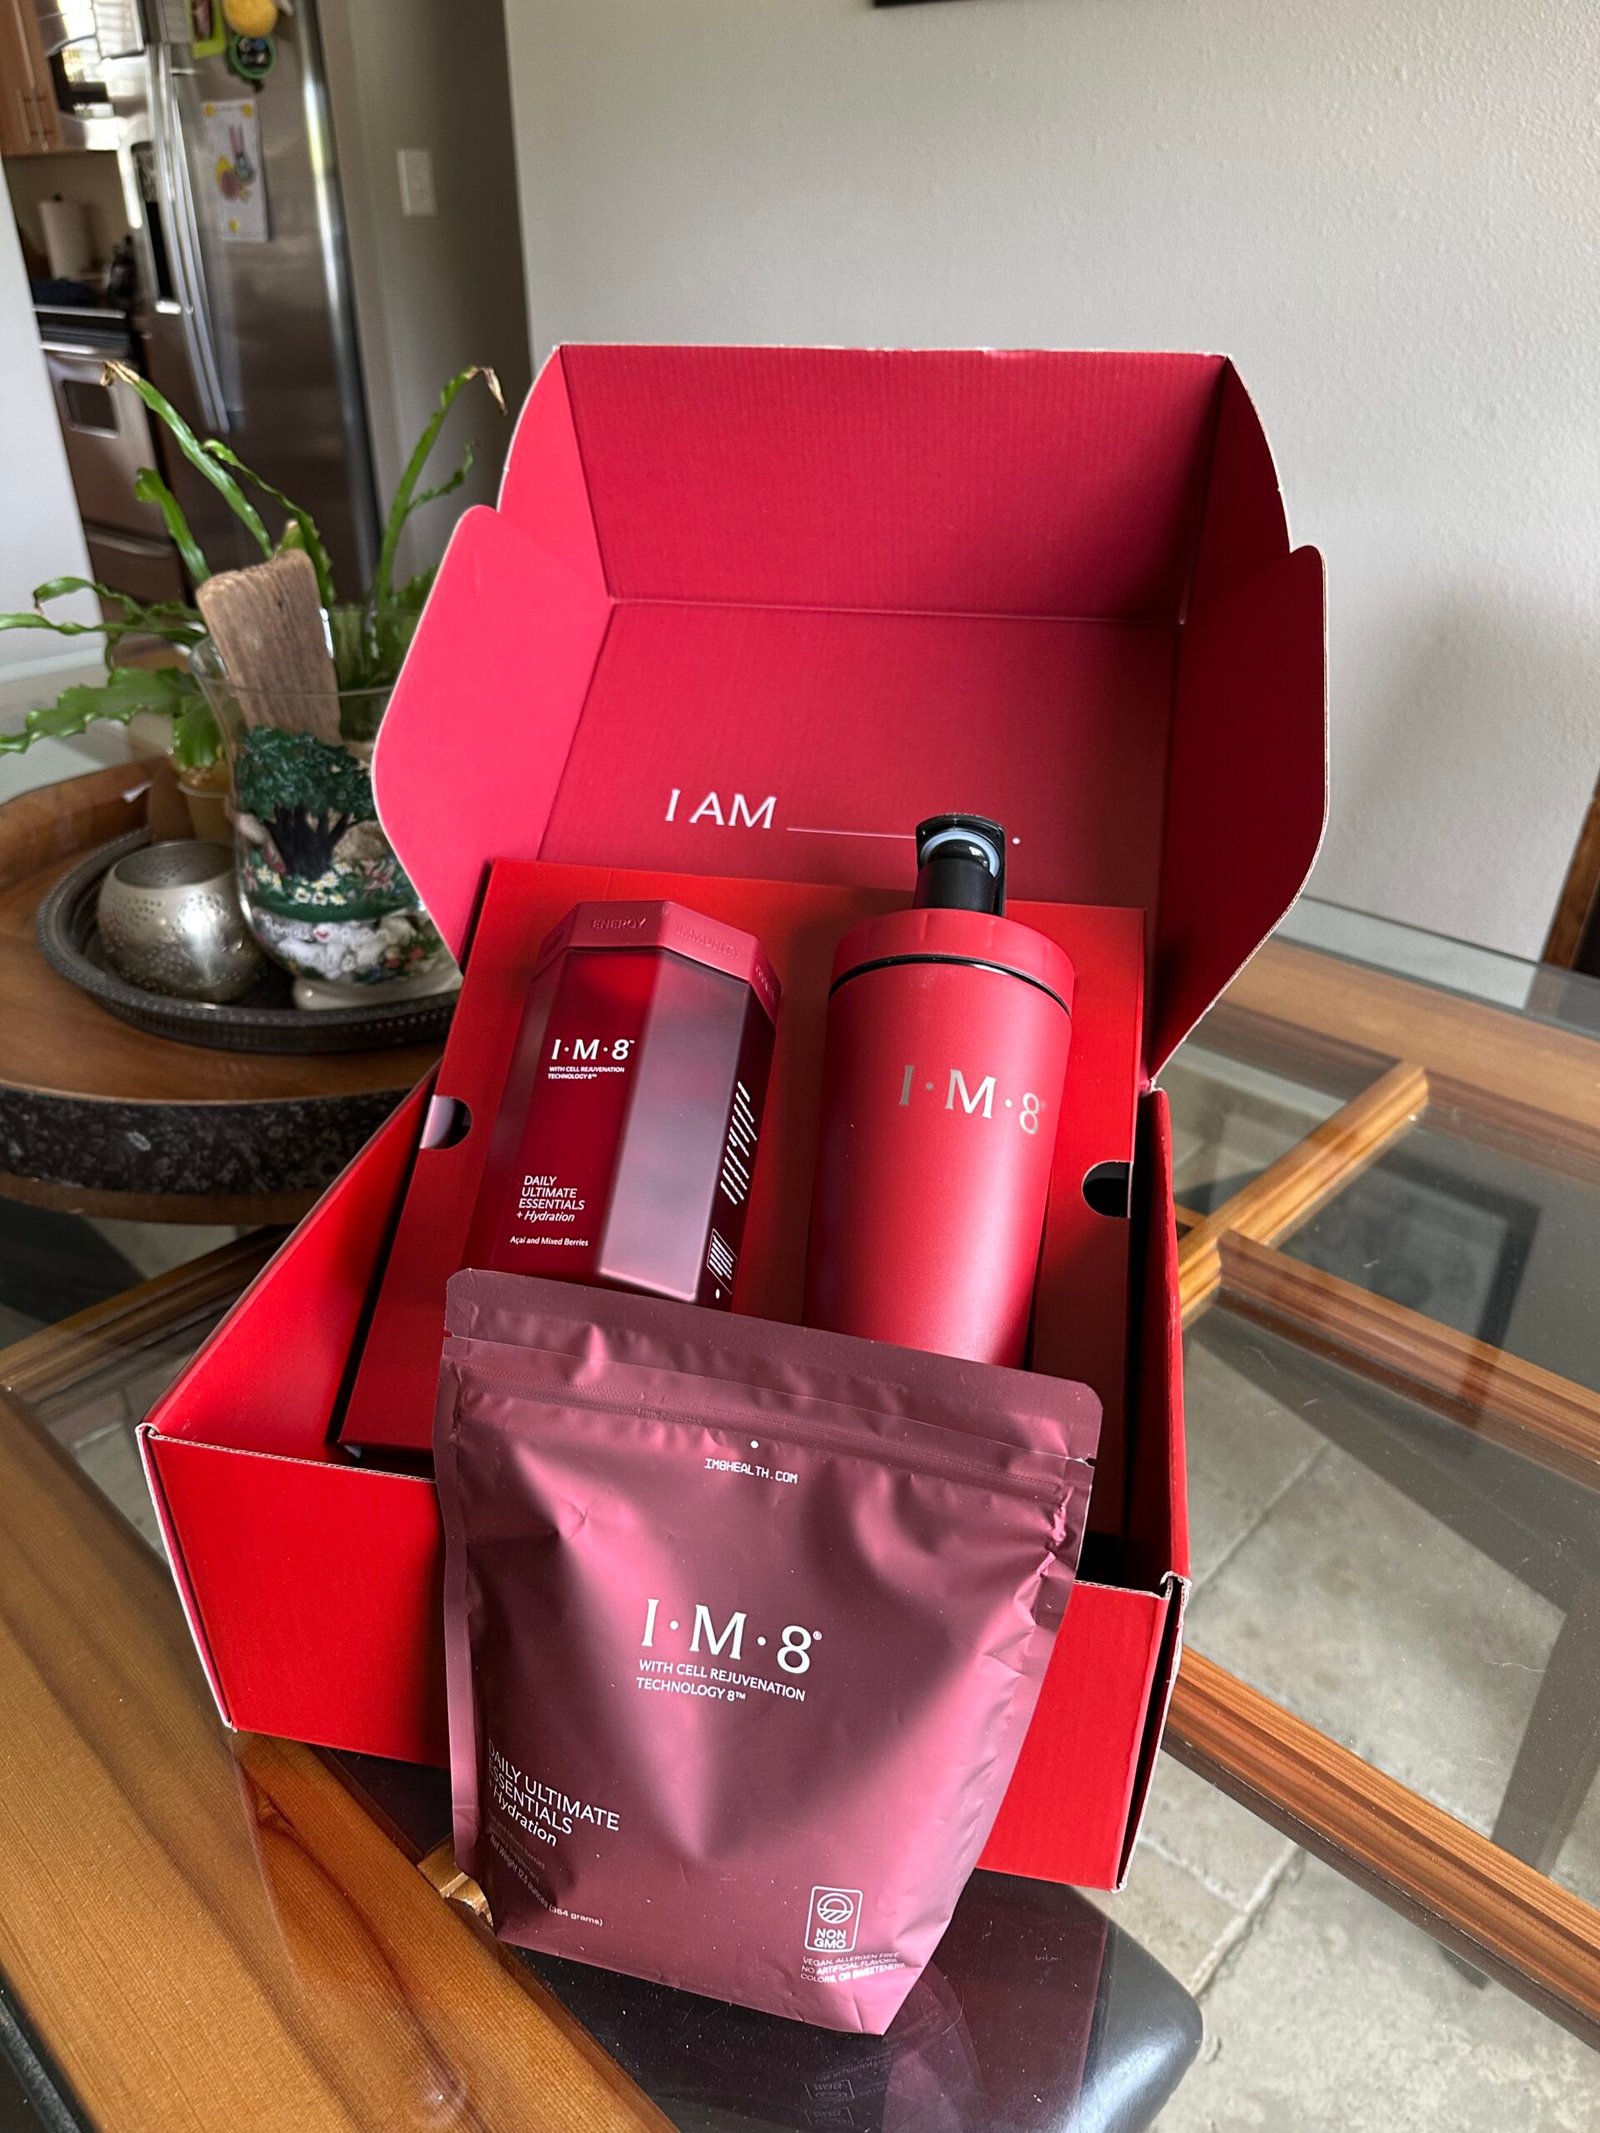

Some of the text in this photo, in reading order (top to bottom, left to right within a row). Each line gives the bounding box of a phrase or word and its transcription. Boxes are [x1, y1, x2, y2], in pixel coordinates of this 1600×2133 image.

[665, 788, 777, 829] I AM
[591, 917, 647, 930] ENERGY
[523, 1175, 557, 1186] DAILY
[521, 1187, 578, 1199] ULTIMATE
[518, 1198, 586, 1211] ESSENTIALS
[516, 1210, 576, 1223] + Hydration
[526, 1237, 540, 1245] and
[541, 1237, 563, 1246] Mixed
[564, 1237, 589, 1247] Berries
[704, 1457, 798, 1485] IM8HEALTH.COM
[639, 1659, 806, 1702] WITH CELL REJUVENATION
[636, 1677, 726, 1700] TECHNOLOGY
[488, 1737, 621, 1832] DAILY ULTIMATE
[488, 1756, 573, 1835] ESSENTIALS
[493, 1785, 557, 1847] Hydration
[527, 1881, 550, 1909] ounces
[570, 1911, 604, 1928] grams)
[815, 1927, 847, 1940] NON
[813, 1937, 847, 1950] GMO
[835, 1953, 878, 1965] ALLERGEN
[801, 1965, 815, 1975] NO
[816, 1962, 859, 1976] ARTIFICIAL
[838, 1971, 852, 1982] OR
